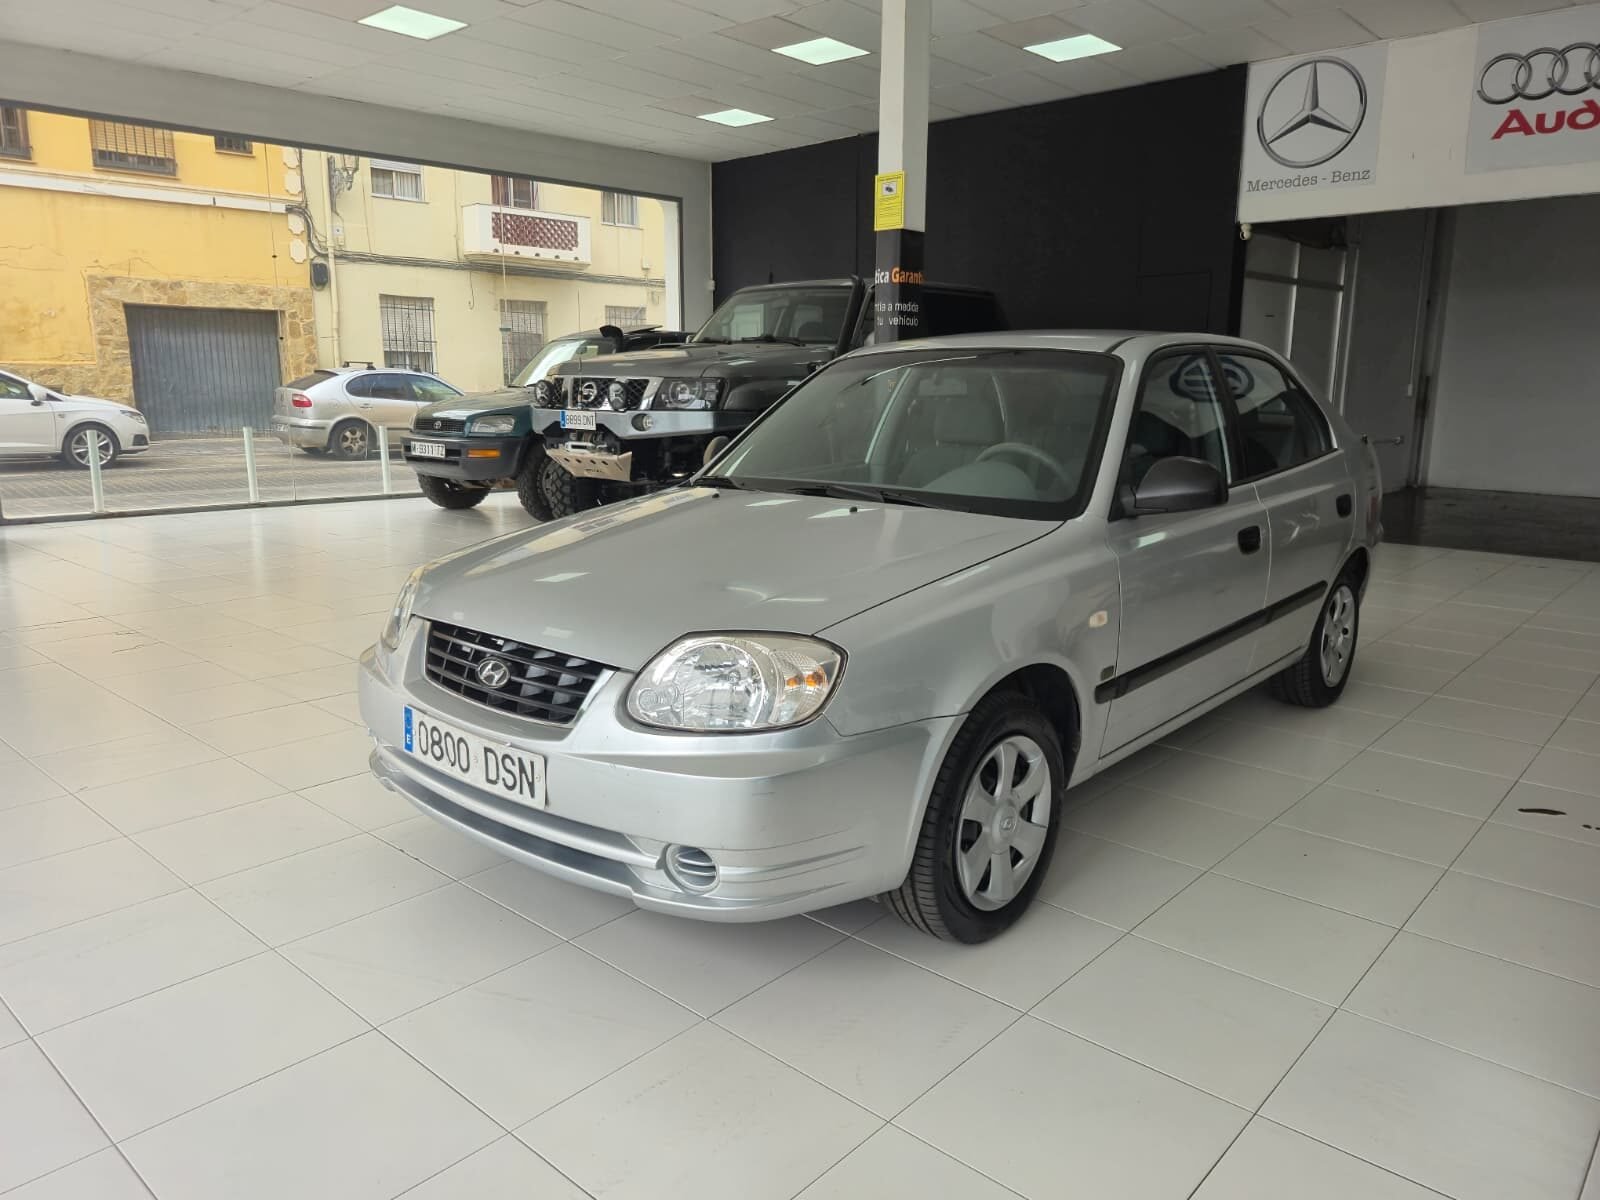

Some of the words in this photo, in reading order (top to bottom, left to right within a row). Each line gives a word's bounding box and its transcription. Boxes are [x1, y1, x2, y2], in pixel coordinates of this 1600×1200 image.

[1246, 174, 1318, 193] Mercedes
[1331, 169, 1371, 184] Benz
[894, 302, 919, 312] medida
[405, 733, 412, 745] E
[418, 720, 471, 774] 0800
[484, 746, 536, 799] DSN
